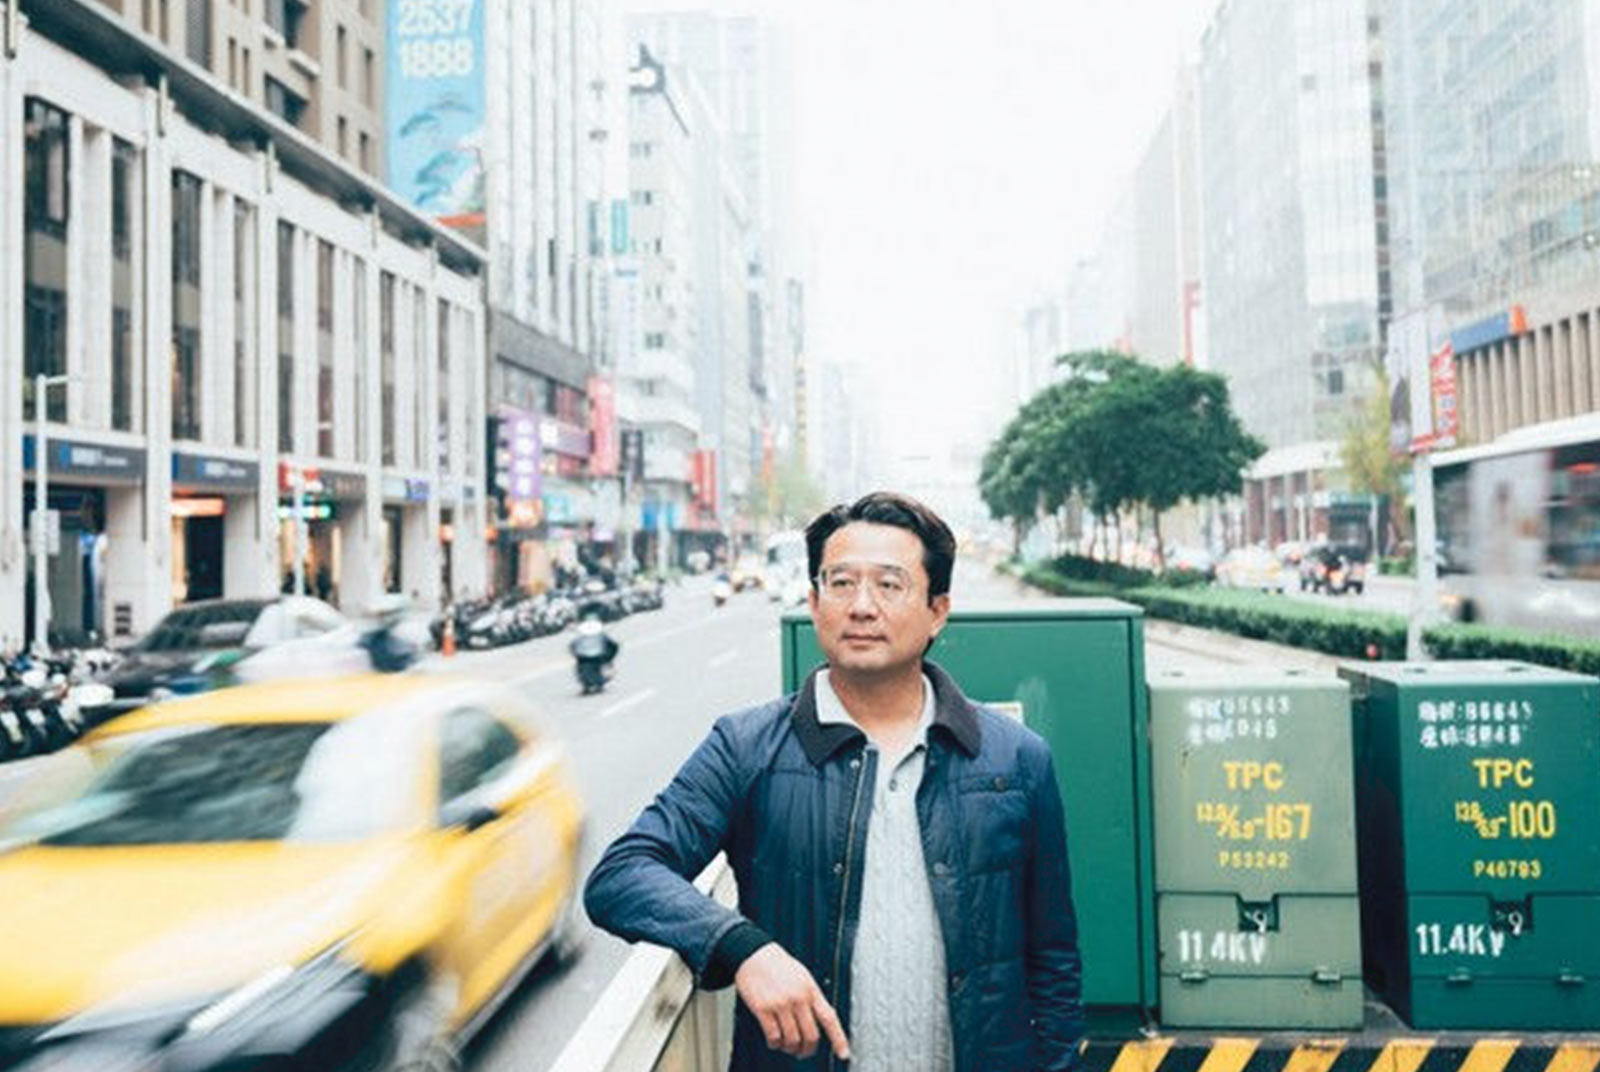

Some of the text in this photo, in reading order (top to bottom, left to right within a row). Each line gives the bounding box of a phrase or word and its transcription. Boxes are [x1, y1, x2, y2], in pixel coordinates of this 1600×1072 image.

[398, 0, 474, 32] 2537
[400, 37, 474, 76] 1888
[1222, 759, 1285, 791] TPC
[1471, 757, 1534, 789] TPC
[1177, 929, 1267, 965] 114KV
